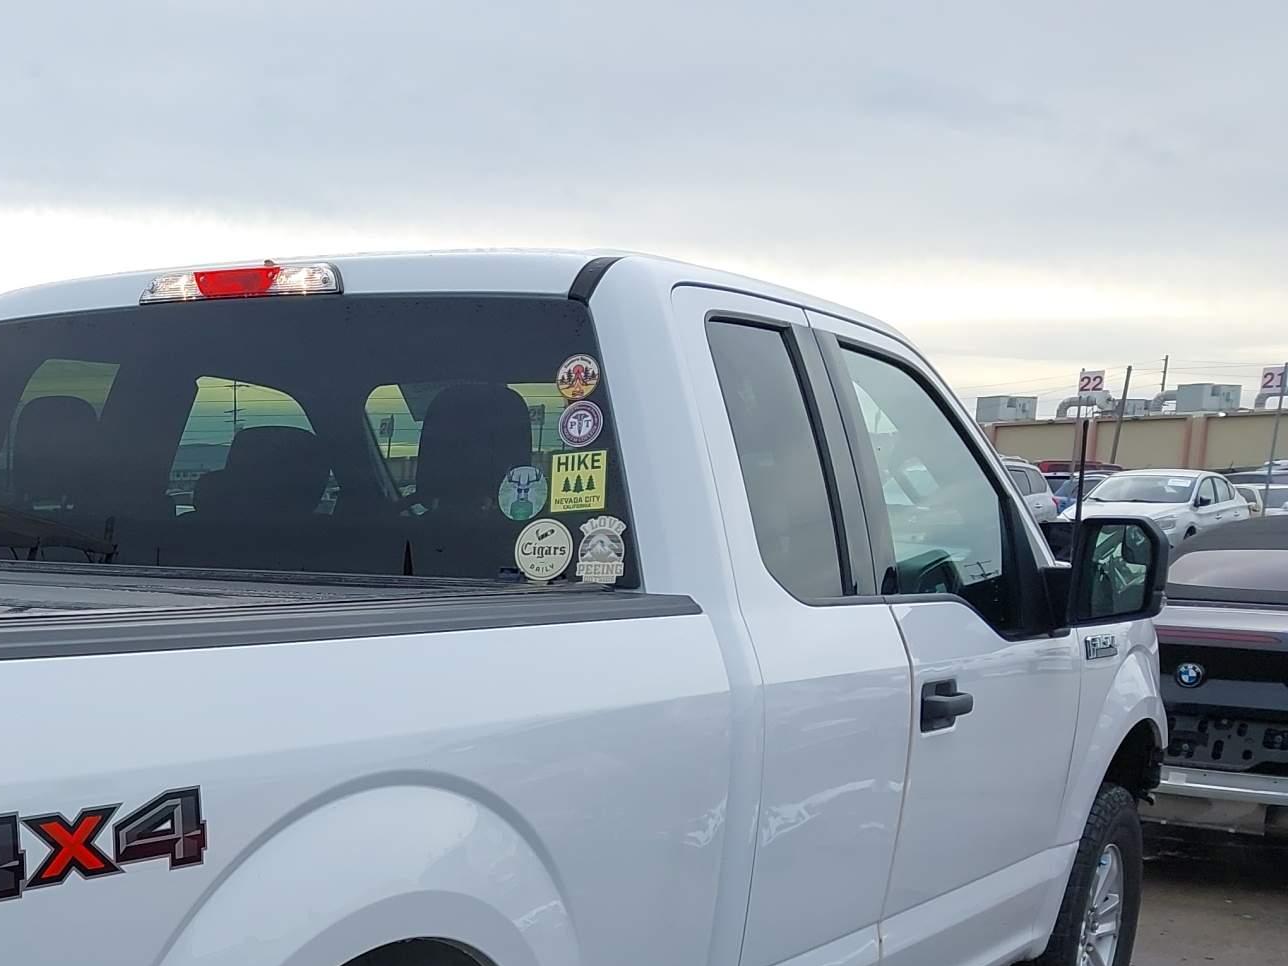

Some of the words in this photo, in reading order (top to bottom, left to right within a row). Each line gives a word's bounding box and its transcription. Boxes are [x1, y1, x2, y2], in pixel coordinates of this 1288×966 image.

[1080, 376, 1103, 391] 22
[1262, 373, 1285, 388] 21
[570, 421, 577, 429] P
[584, 420, 592, 428] T
[557, 452, 602, 472] HIKE
[554, 496, 583, 505] NEVADA
[584, 495, 601, 503] CITY
[591, 516, 624, 534] LOVE
[521, 542, 566, 558] Cigars
[529, 564, 555, 572] DAILY
[578, 563, 623, 575] PEEING
